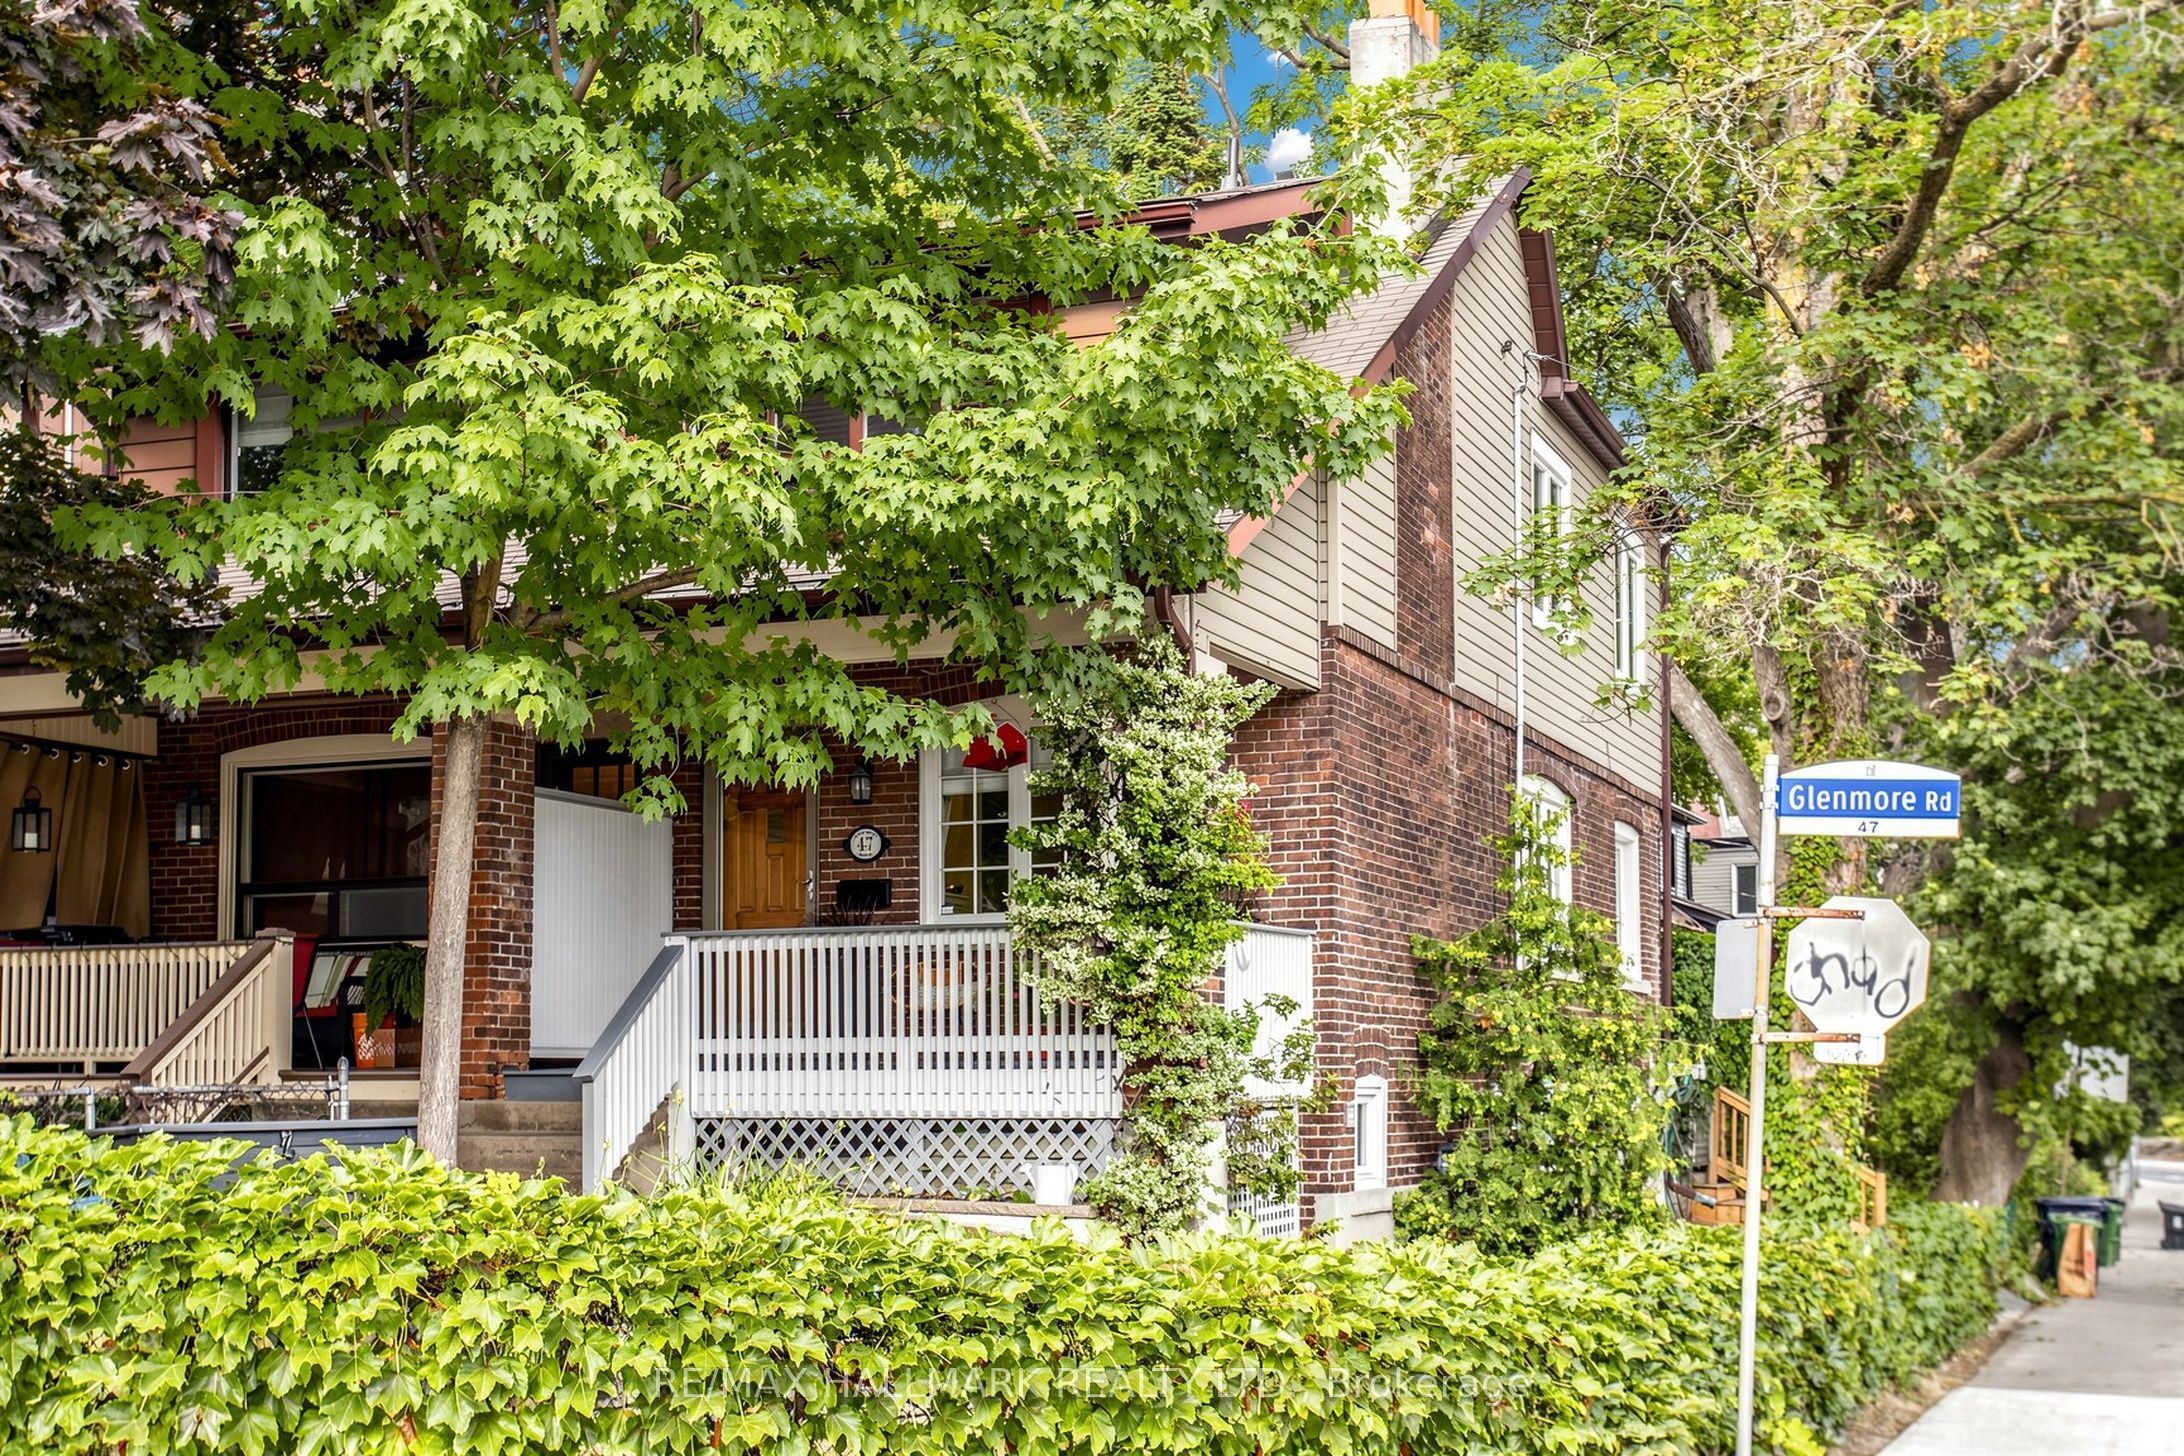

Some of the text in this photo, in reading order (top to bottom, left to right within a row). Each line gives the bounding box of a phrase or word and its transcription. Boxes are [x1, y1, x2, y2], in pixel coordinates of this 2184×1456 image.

[1788, 784, 1952, 812] Glenmore Rd
[1858, 821, 1879, 834] 47
